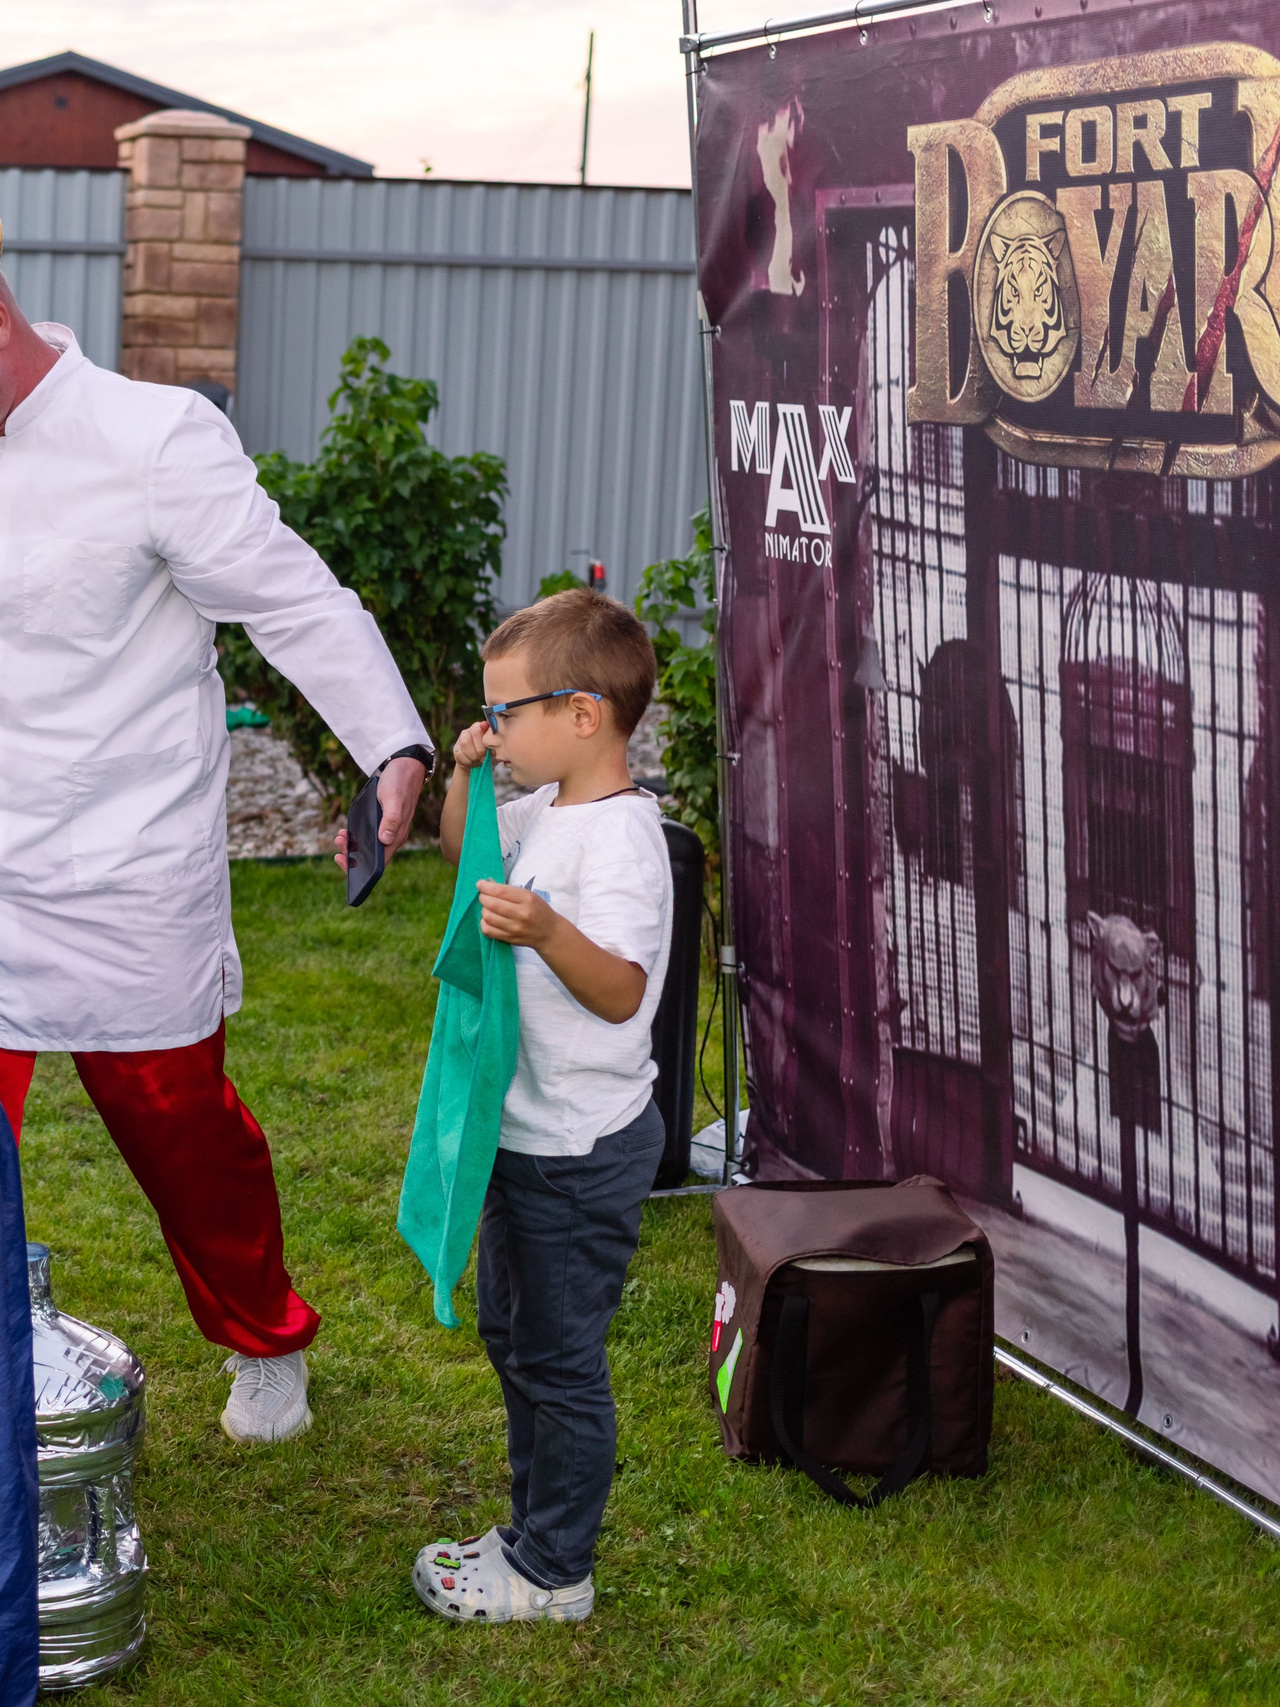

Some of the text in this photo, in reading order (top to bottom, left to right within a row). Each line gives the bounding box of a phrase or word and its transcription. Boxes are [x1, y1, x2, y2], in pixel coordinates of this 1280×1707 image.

[1024, 92, 1212, 182] FORT
[729, 399, 857, 535] MAX
[764, 531, 833, 569] NIMATOR
